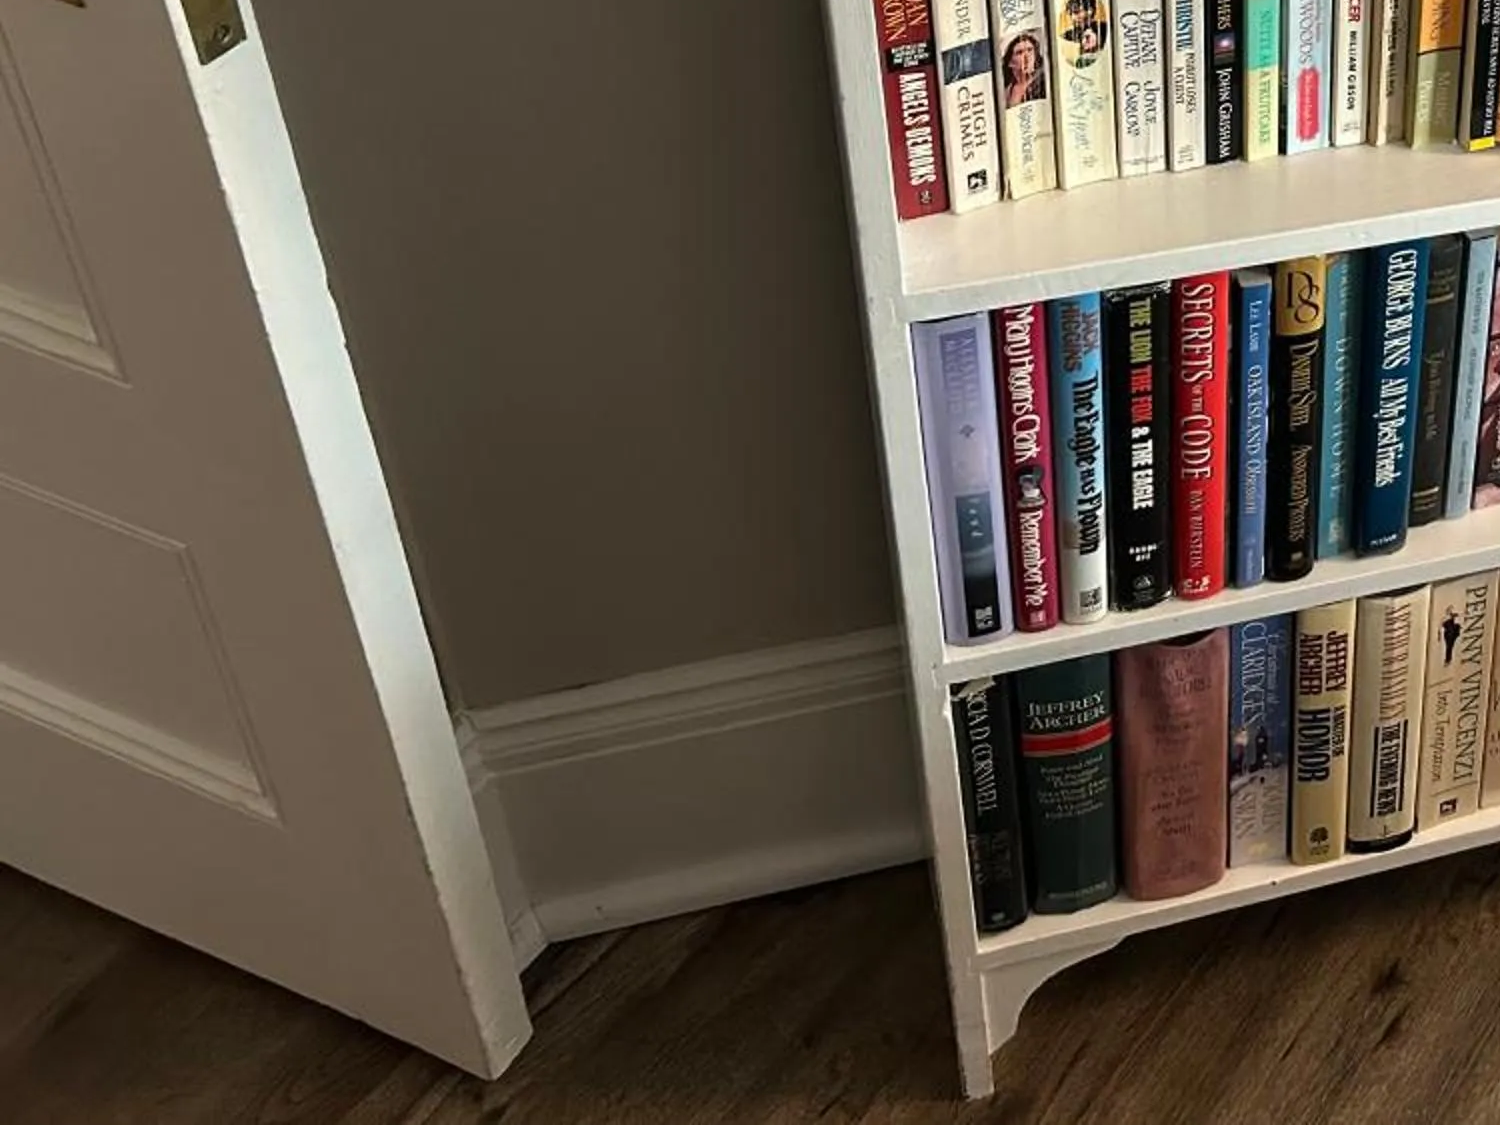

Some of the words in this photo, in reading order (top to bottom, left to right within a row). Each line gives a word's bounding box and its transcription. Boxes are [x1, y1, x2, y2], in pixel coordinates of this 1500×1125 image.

[1120, 11, 1141, 70] CAPTIVE
[1299, 2, 1316, 65] WOODS
[1347, 31, 1358, 71] WILLIAM
[899, 72, 931, 126] ANGELS
[1143, 81, 1161, 127] JOYCE
[1216, 66, 1233, 101] JOHN
[1346, 75, 1357, 111] GIBSON
[957, 86, 975, 162] CRIMES
[971, 91, 988, 148] HIGH
[1217, 102, 1235, 158] GRISHAM
[905, 127, 937, 186] DEMONS
[1386, 250, 1417, 316] GEORGE
[1003, 305, 1034, 355] Mary
[1129, 299, 1152, 328] THE
[1180, 283, 1216, 383] SECRETS
[1129, 331, 1152, 364] LION
[1289, 338, 1319, 392] DANIELLE
[1381, 316, 1412, 370] BURNS
[1007, 358, 1037, 416] Higgins
[1072, 373, 1101, 414] The
[1131, 365, 1152, 394] THE
[1247, 364, 1263, 399] OAK
[1380, 378, 1408, 398] All
[1131, 426, 1150, 438] &
[1132, 395, 1153, 423] FOX
[1246, 402, 1263, 456] ISLAND
[1288, 391, 1316, 432] STEEL
[1372, 400, 1407, 418] My
[1011, 415, 1042, 463] Clark
[1067, 413, 1101, 468] Eagle
[1131, 439, 1154, 468] THE
[1180, 414, 1214, 480] CODE
[1377, 420, 1406, 445] Best
[1374, 444, 1403, 488] Friends
[1131, 470, 1154, 511] EAGLE
[1188, 490, 1203, 512] DAN
[1019, 510, 1044, 584] Remember
[1077, 492, 1103, 556] Flown
[1024, 584, 1047, 607] Me
[1459, 585, 1489, 665] PENNY
[1300, 634, 1323, 696] ARCHER
[1325, 631, 1348, 692] JEFFREY
[1027, 690, 1105, 716] JEFFREY
[1029, 704, 1106, 730] ARCHER
[1436, 689, 1453, 716] Into
[1297, 708, 1331, 783] HONOR
[1381, 723, 1401, 743] THE
[1453, 670, 1483, 782] VINCENZI
[1379, 743, 1400, 786] EVENING
[1429, 718, 1451, 782] Temptation
[1376, 786, 1398, 818] NEWS
